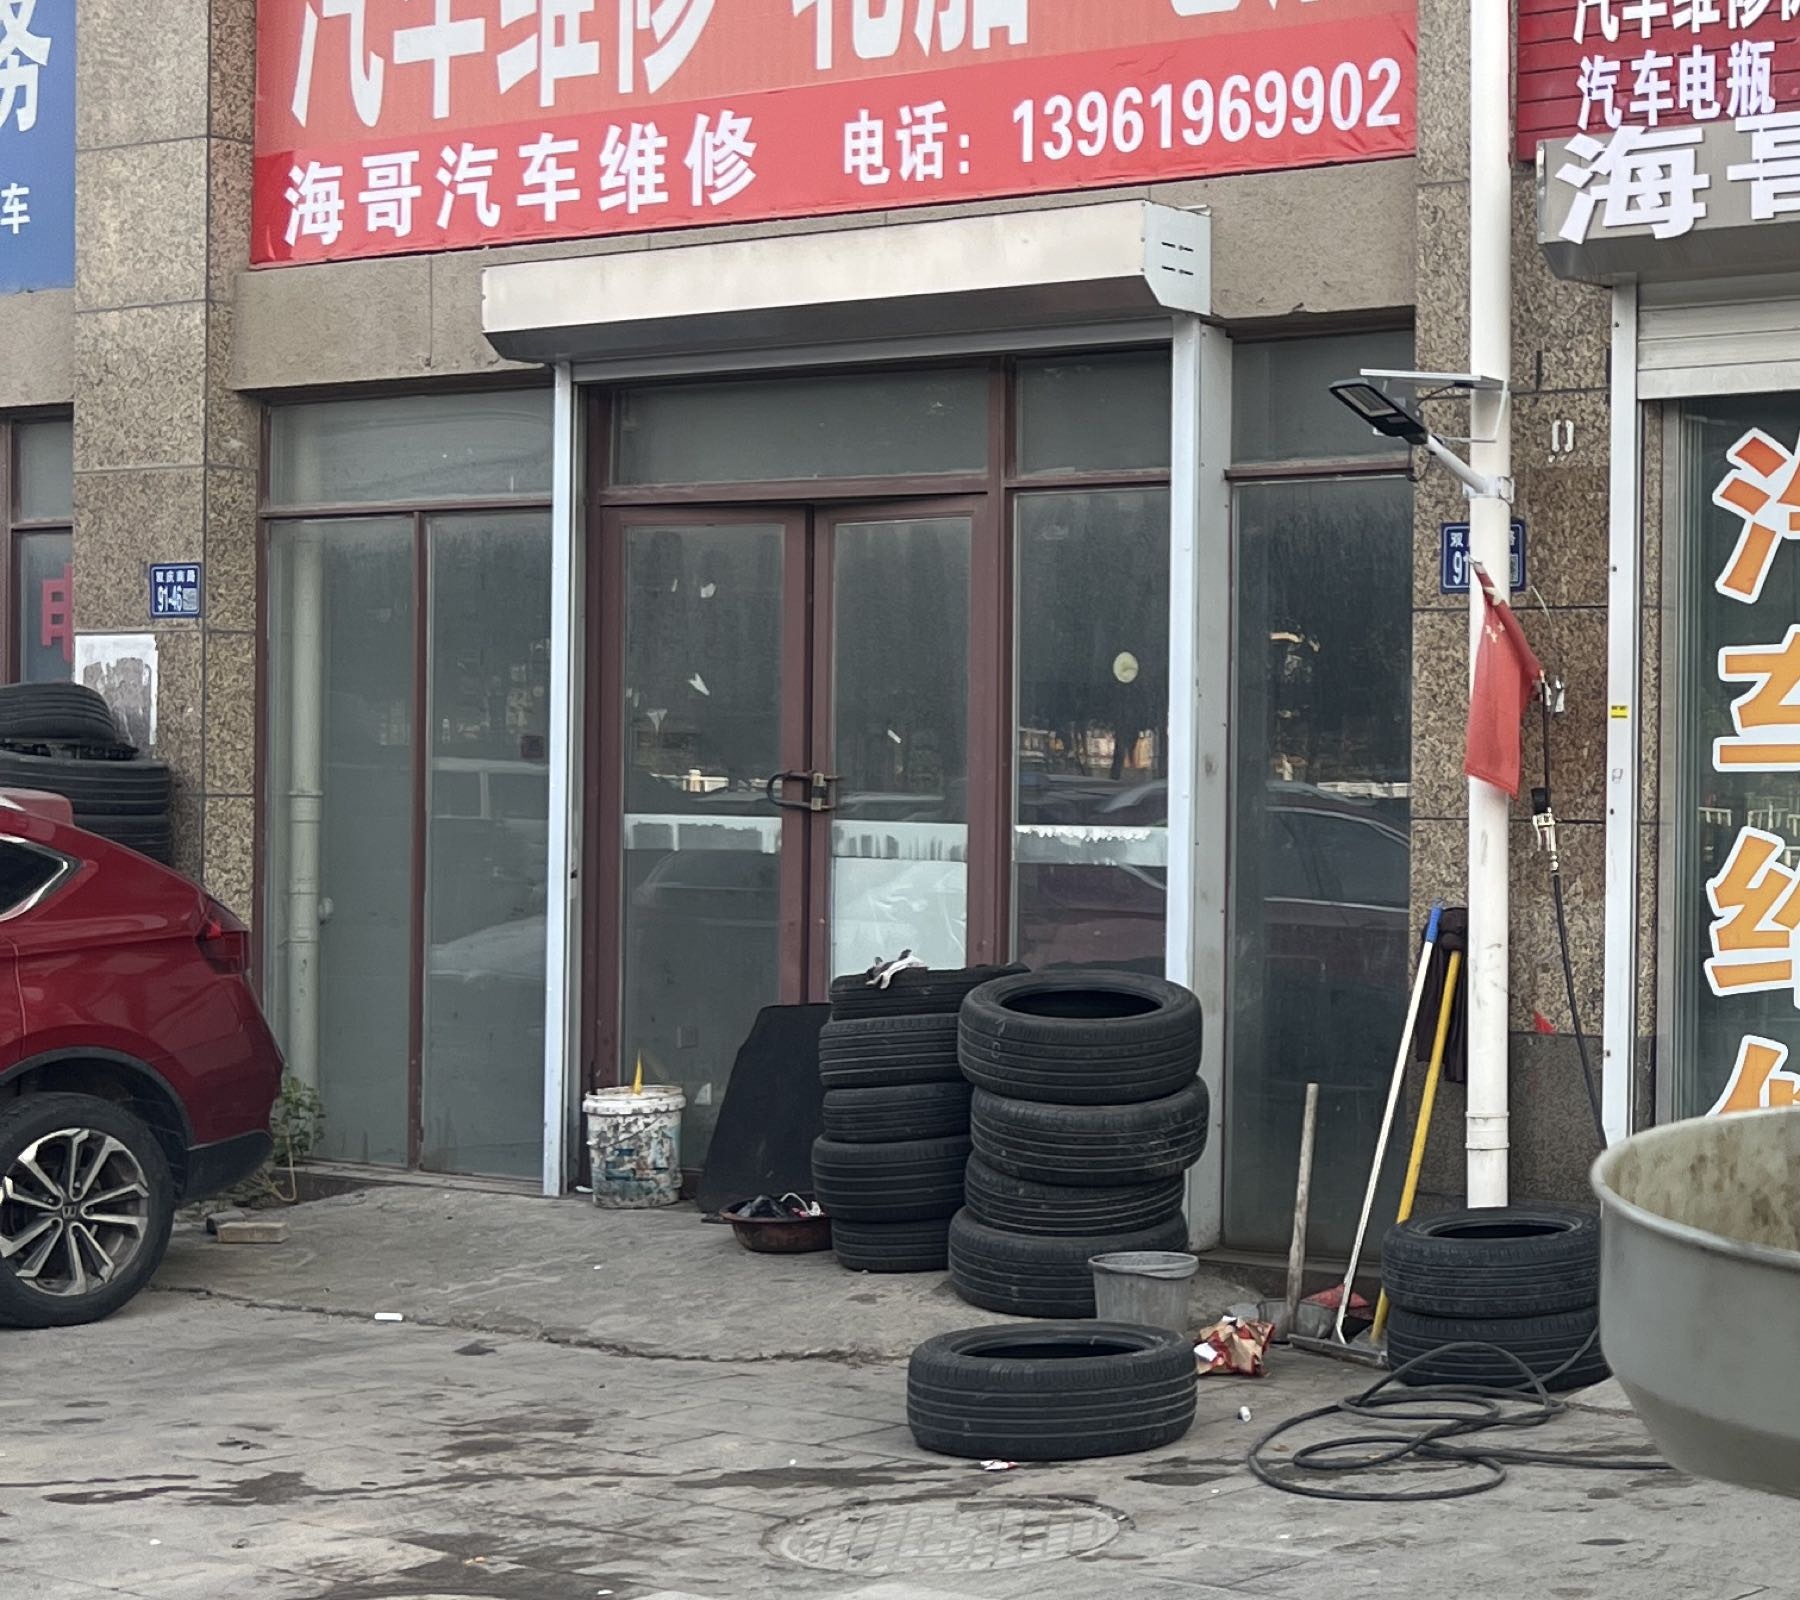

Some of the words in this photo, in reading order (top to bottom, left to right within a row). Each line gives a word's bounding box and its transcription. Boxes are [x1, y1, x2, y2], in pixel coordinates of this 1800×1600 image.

[1576, 39, 1776, 131] 汽车电瓶
[285, 107, 758, 247] 海哥汽车维修
